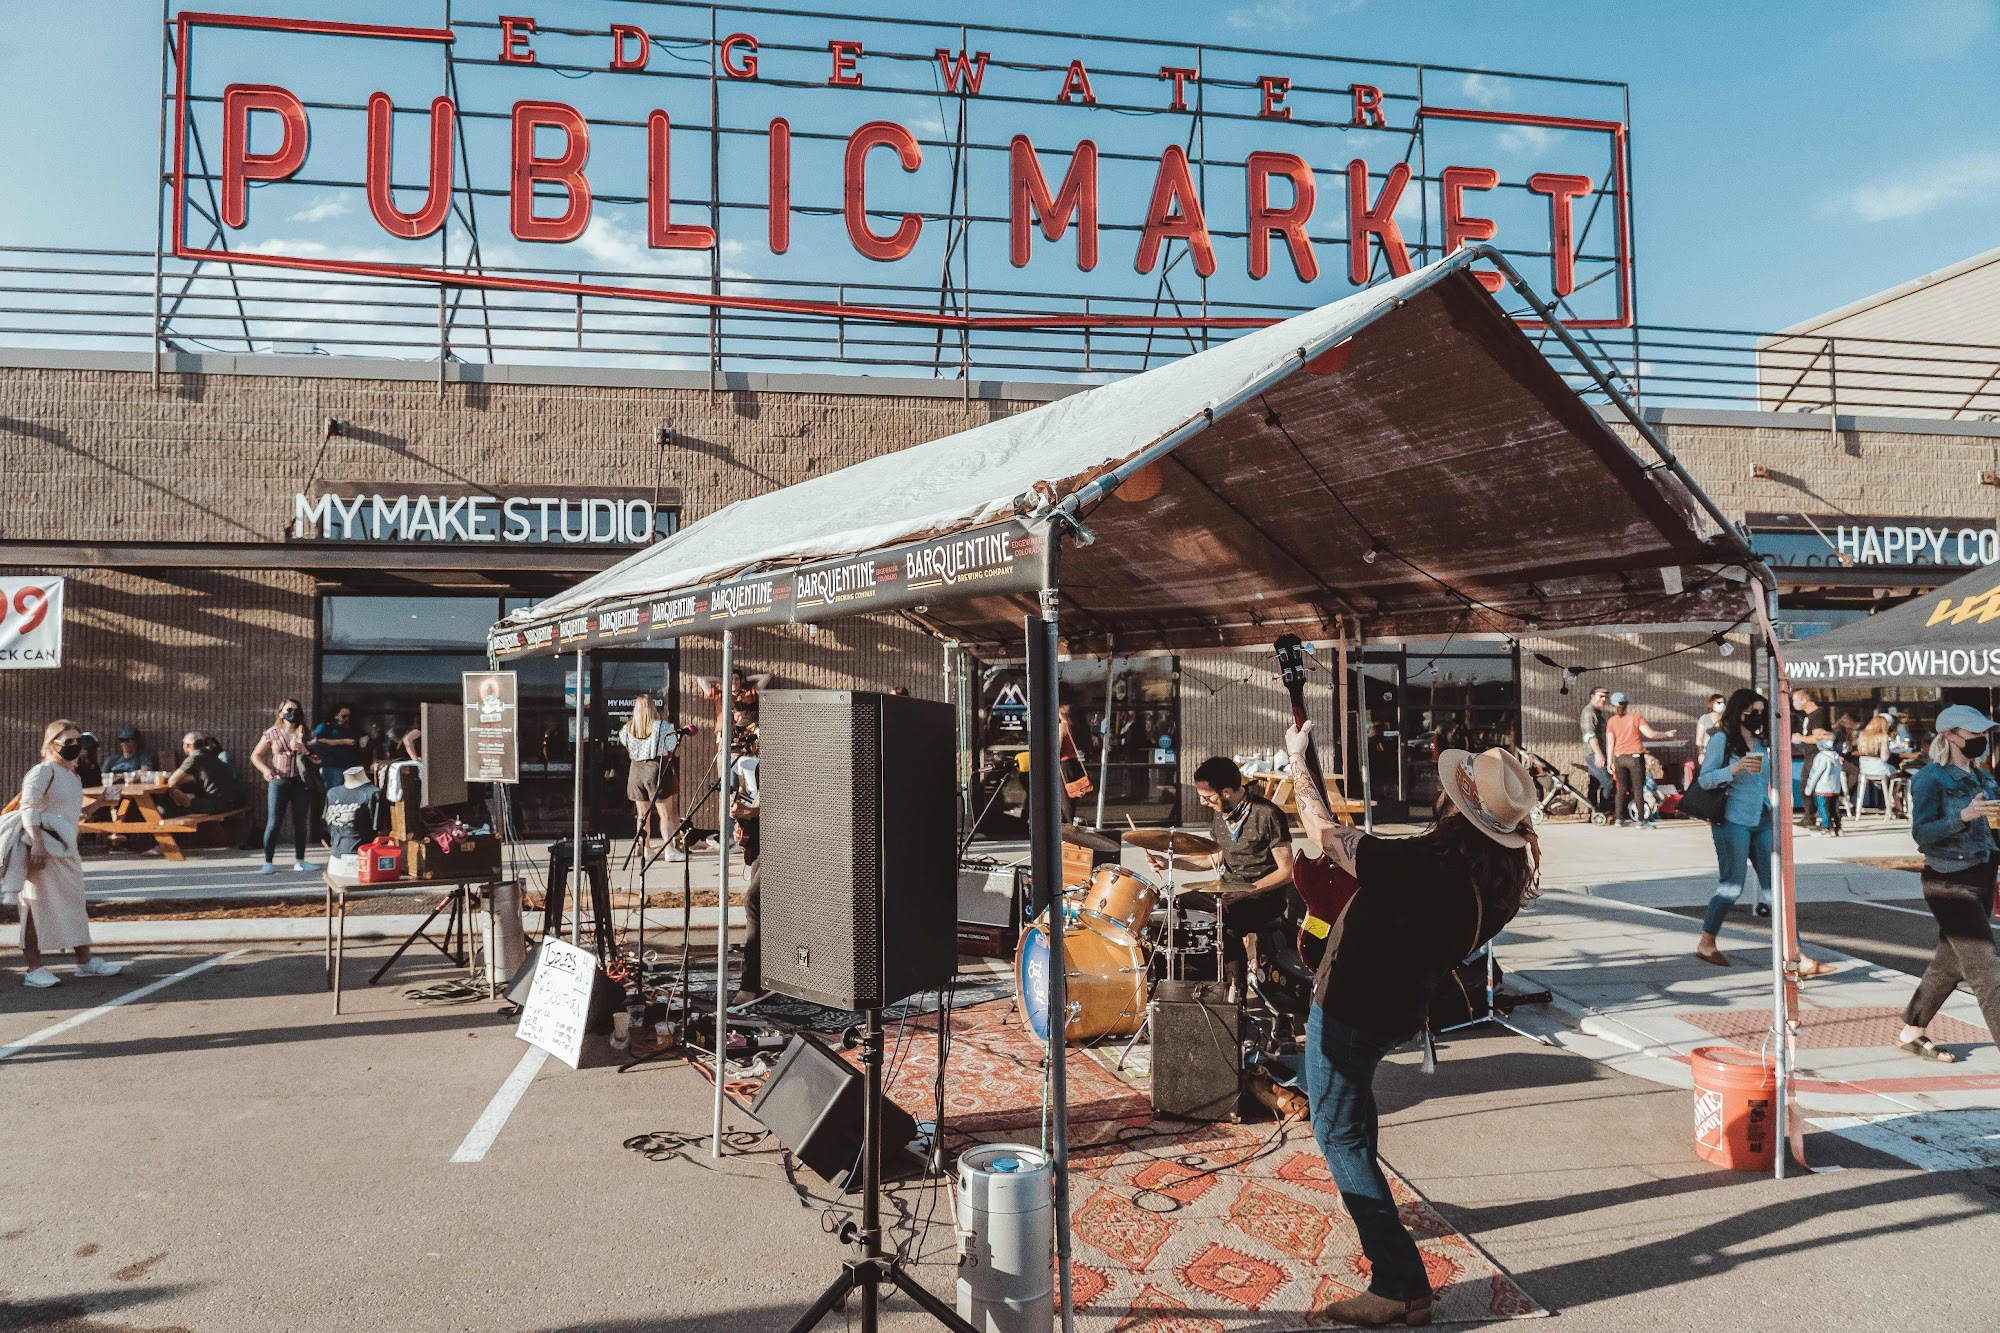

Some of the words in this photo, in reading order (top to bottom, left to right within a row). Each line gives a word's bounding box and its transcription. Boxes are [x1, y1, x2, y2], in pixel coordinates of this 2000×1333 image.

[498, 15, 1387, 128] EDGEWATER
[221, 83, 923, 263] PUBLIC
[1009, 133, 1594, 299] MARKET
[295, 492, 365, 539] MY
[371, 494, 496, 541] MAKE
[502, 497, 655, 543] STUDIO
[907, 532, 1013, 585] BARQUENTINE
[1837, 525, 1949, 565] HAPPY
[797, 561, 877, 604] BARQUENTINE
[957, 571, 983, 583] BREWING
[984, 566, 1013, 578] COMPANY
[0, 586, 48, 635] 9
[652, 596, 696, 628] BARQUENTINE
[711, 581, 773, 617] BARQUENTINE
[600, 608, 639, 636] BARQUENTINE
[23, 649, 55, 660] CAN
